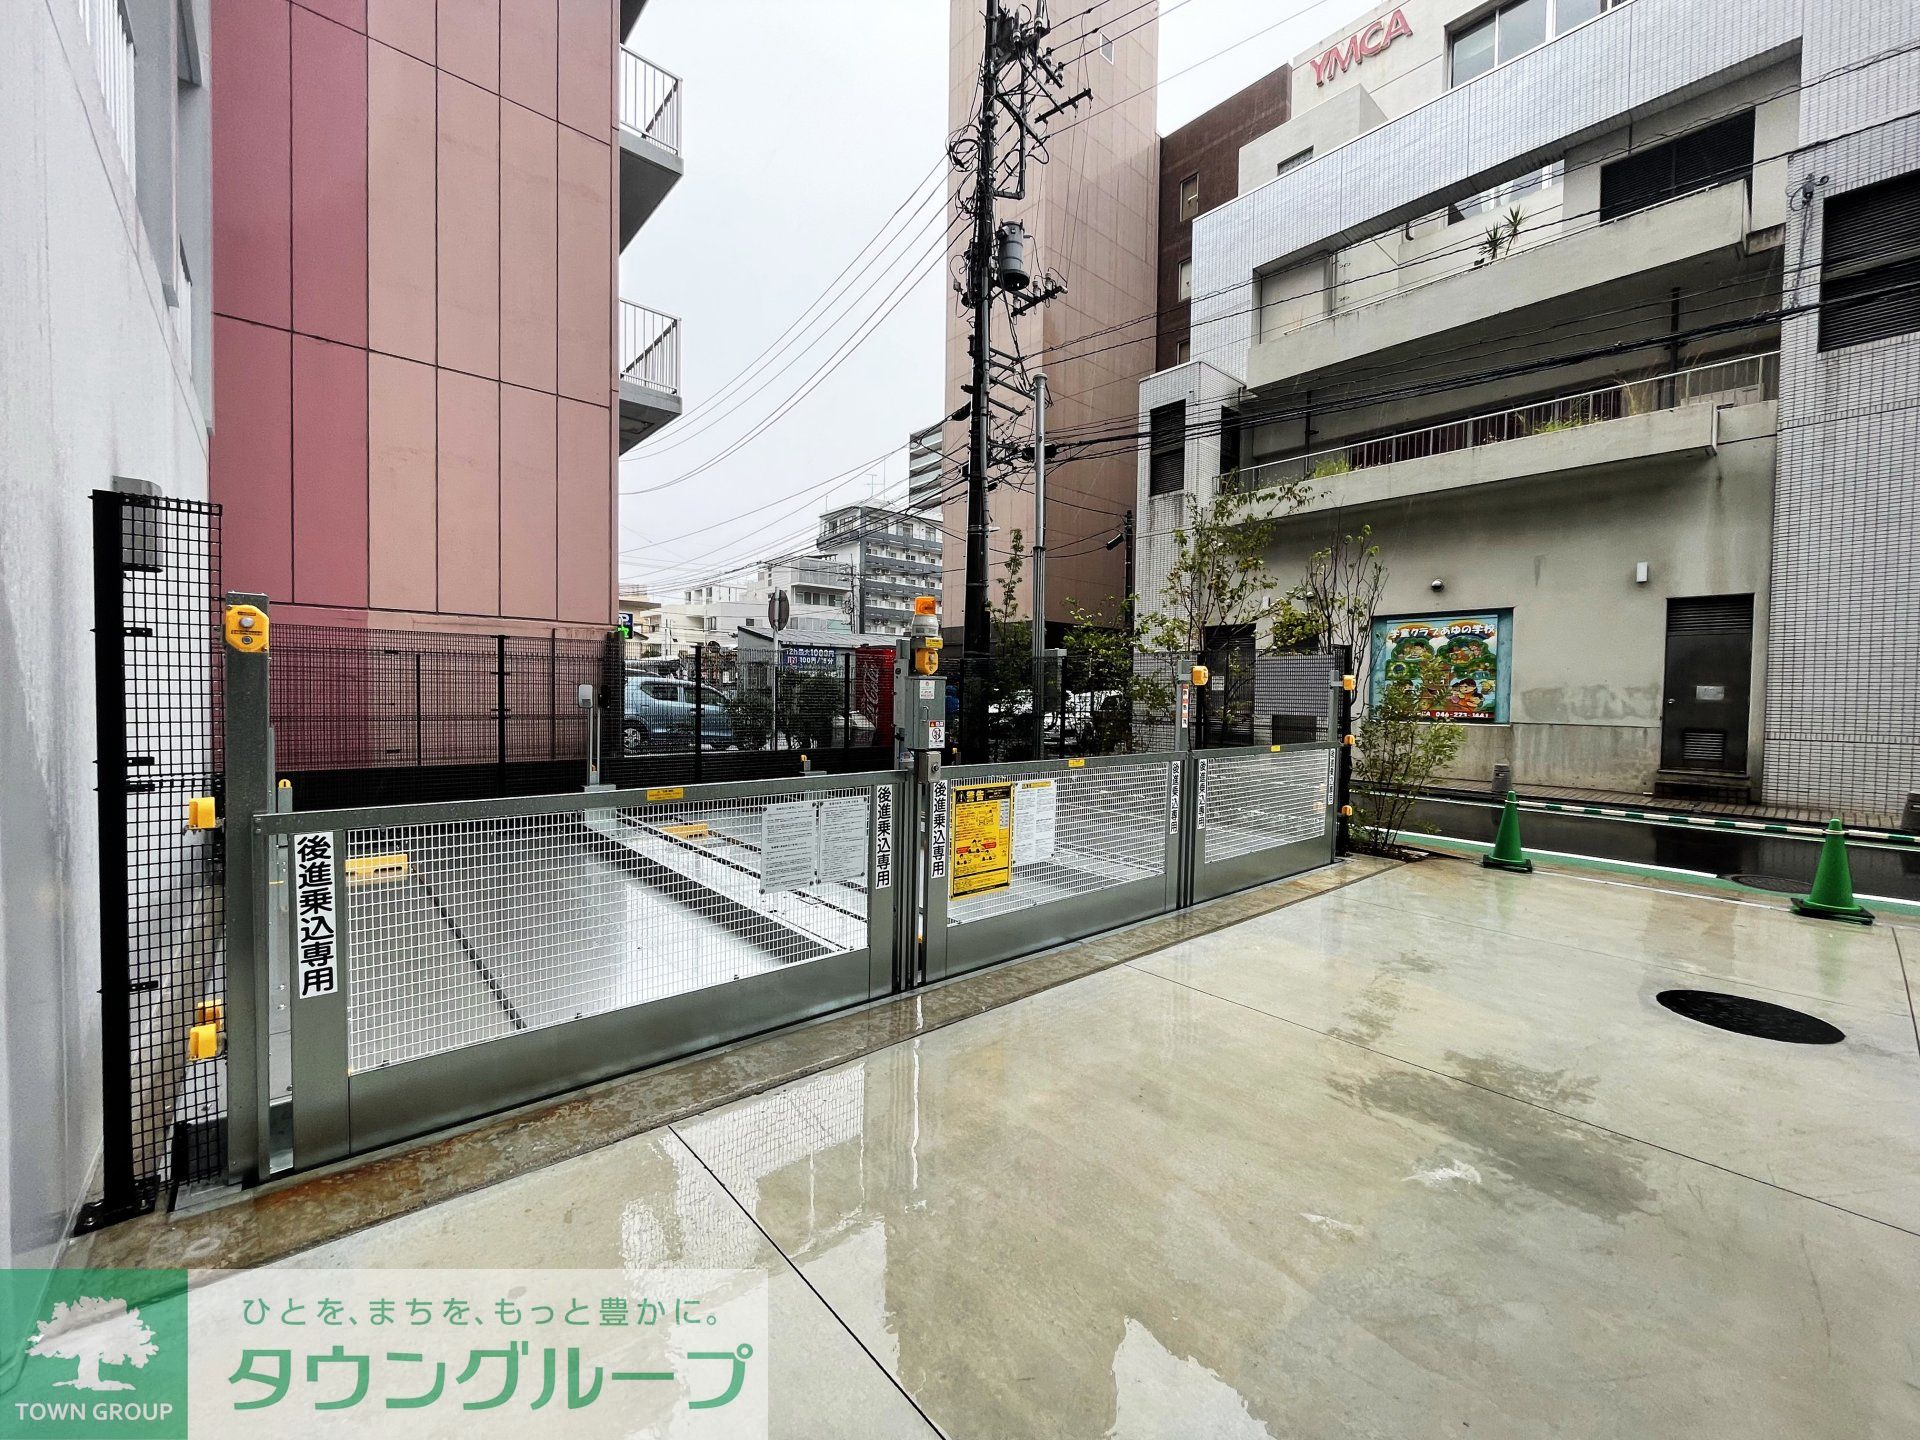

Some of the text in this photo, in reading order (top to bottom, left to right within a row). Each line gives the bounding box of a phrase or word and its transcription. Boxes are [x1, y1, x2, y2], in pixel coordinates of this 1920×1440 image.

[1309, 8, 1414, 88] YMCA
[1390, 624, 1495, 638] 学童クラブあゆの学校
[877, 786, 891, 887] 後進乗込専用
[932, 782, 946, 876] 後進乗込専用
[966, 790, 984, 803] 警告
[297, 835, 334, 995] 後進乗込専用
